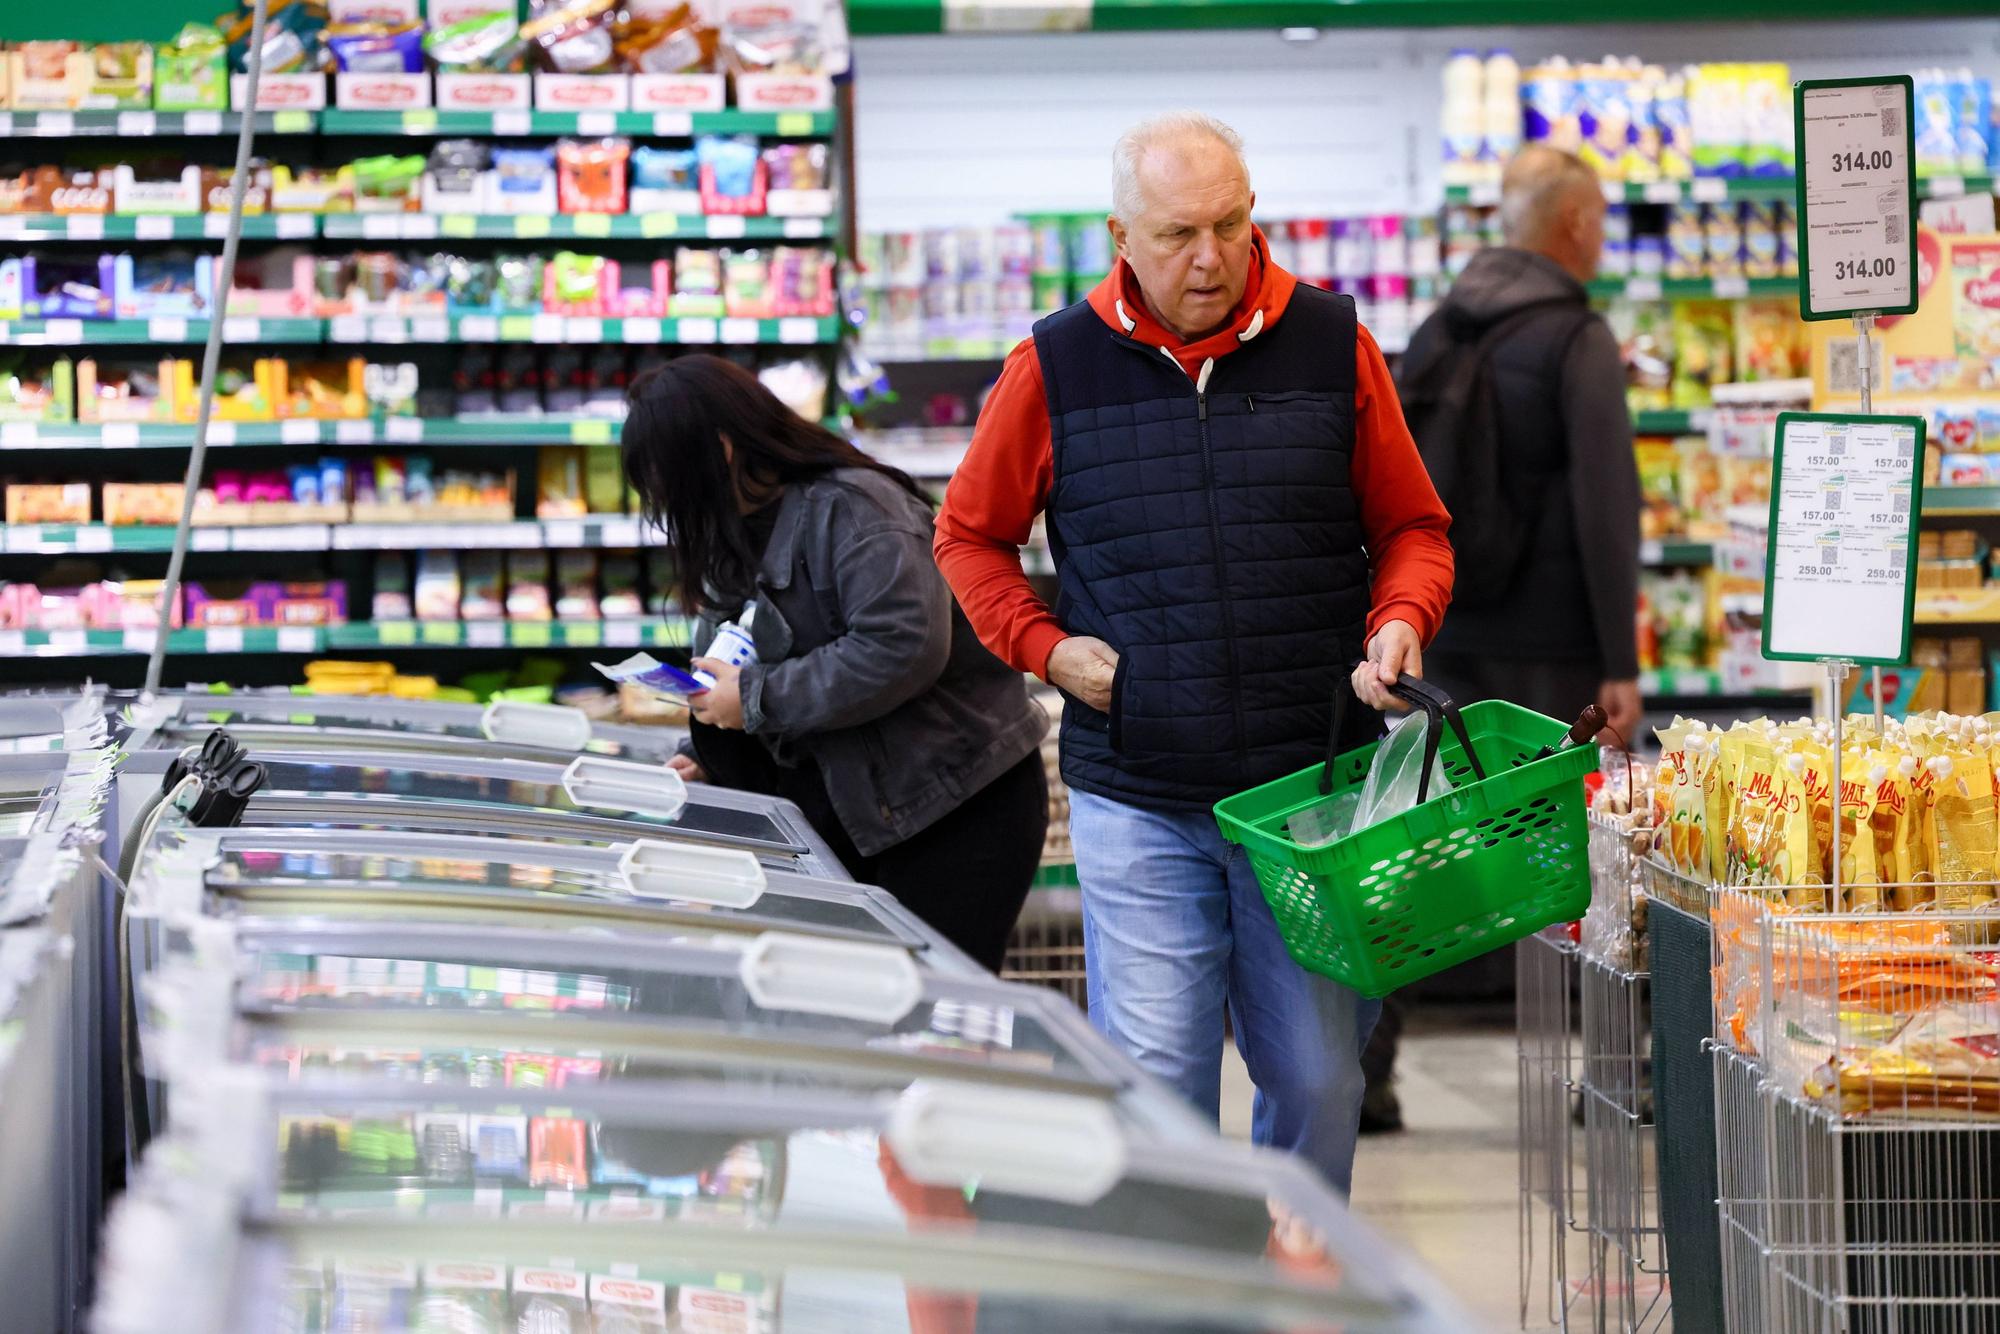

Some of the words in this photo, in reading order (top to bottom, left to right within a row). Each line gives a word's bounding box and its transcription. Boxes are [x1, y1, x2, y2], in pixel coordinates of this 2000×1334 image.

[1832, 150, 1893, 173] 314.00
[1835, 257, 1896, 281] 314.00
[1807, 455, 1840, 466] 157.00
[1874, 458, 1908, 468] 157.00
[1802, 511, 1835, 521] 157.00
[1870, 514, 1904, 524] 157.00
[1798, 565, 1832, 576] 259.00
[1867, 568, 1900, 579] 259.00
